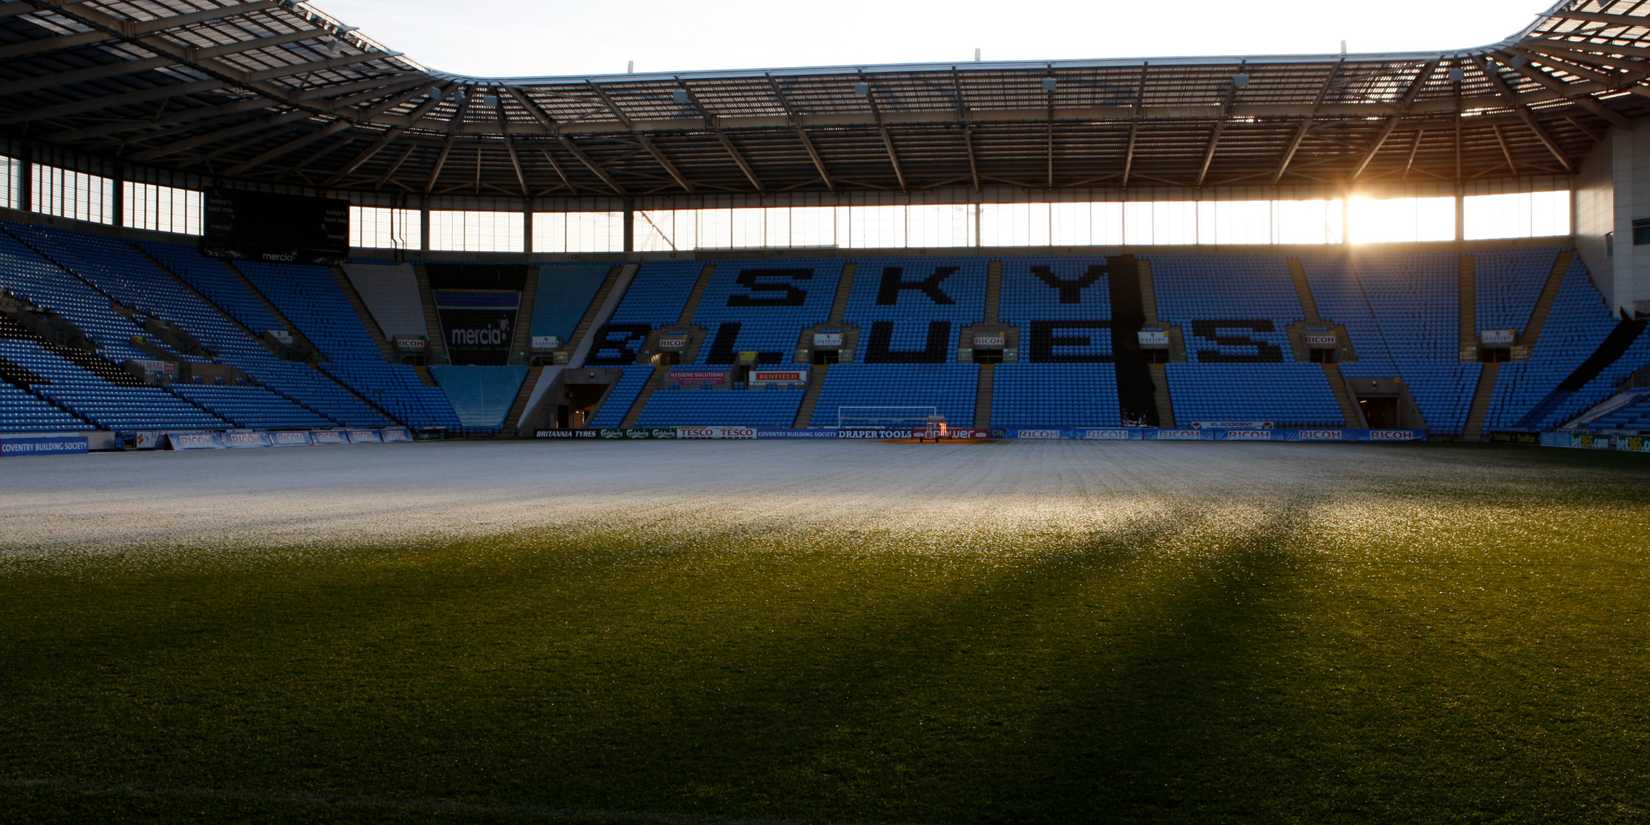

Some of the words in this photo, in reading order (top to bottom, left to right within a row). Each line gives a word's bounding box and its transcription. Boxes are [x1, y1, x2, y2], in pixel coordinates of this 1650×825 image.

[727, 266, 1110, 306] SKY
[452, 323, 501, 345] mercia
[587, 320, 1284, 364] BLUES
[536, 430, 573, 439] BRITANNIA
[575, 430, 597, 439] TYRES
[681, 428, 713, 439] TESCO
[720, 428, 753, 439] TESCO
[838, 430, 878, 439] DRAPER
[880, 430, 912, 439] TOOLS
[924, 429, 975, 440] npwer
[1300, 430, 1341, 440] RICOH
[1370, 430, 1413, 440] RICOH
[1, 443, 34, 453] COVENTRY
[35, 442, 63, 451] BUILDING
[64, 440, 87, 450] SOCIETY
